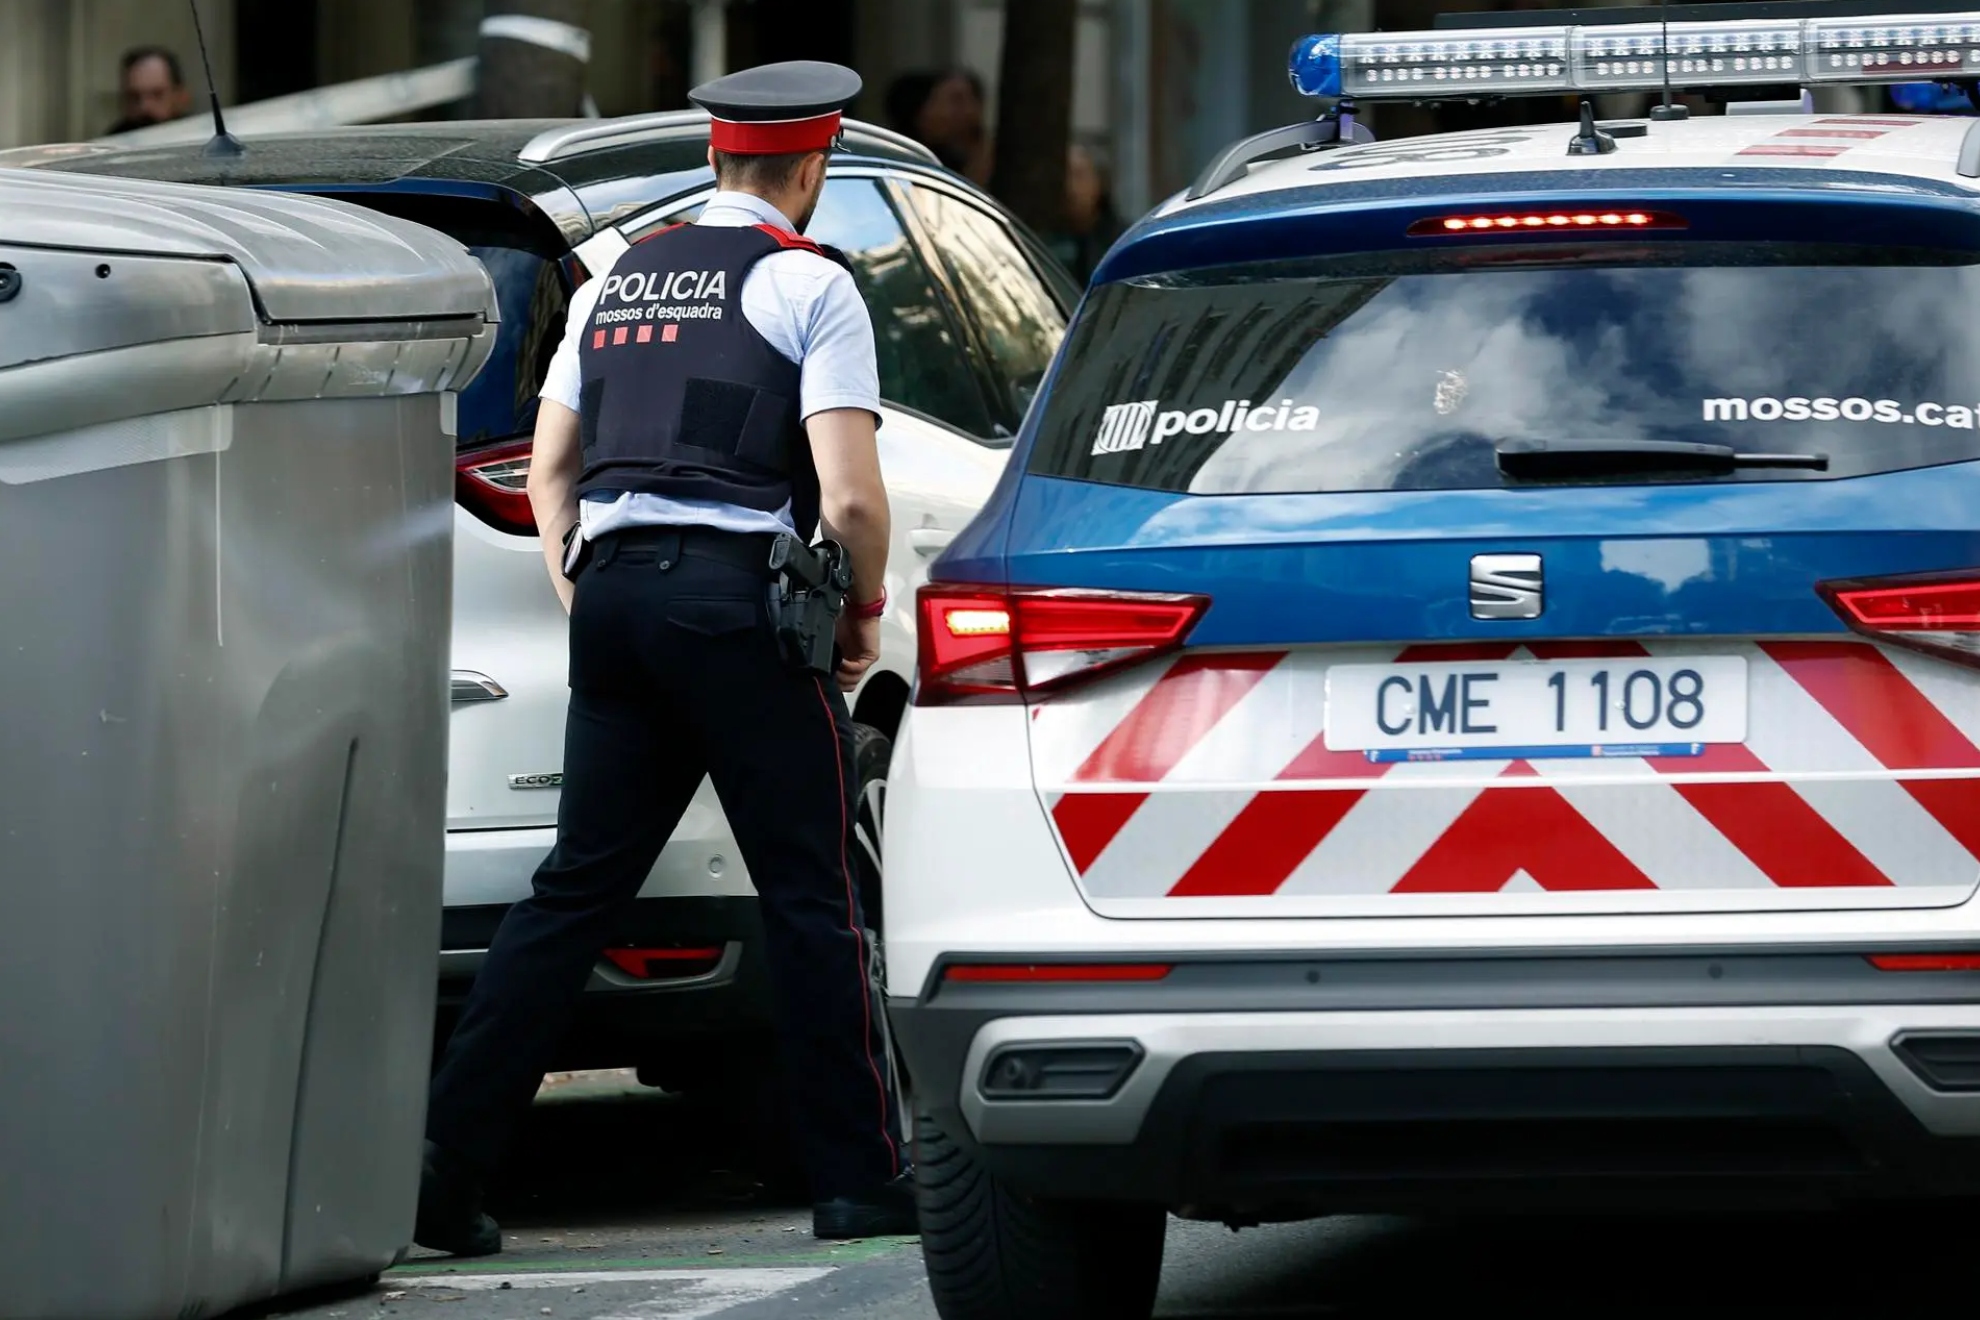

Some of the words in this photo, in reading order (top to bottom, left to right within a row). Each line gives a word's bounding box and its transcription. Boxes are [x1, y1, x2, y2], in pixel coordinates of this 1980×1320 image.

[599, 270, 726, 305] POLICIA
[595, 306, 643, 325] mossos
[645, 302, 722, 321] d'esquadra
[1150, 399, 1320, 444] policia
[1376, 673, 1498, 735] CME
[1548, 669, 1704, 732] 1108
